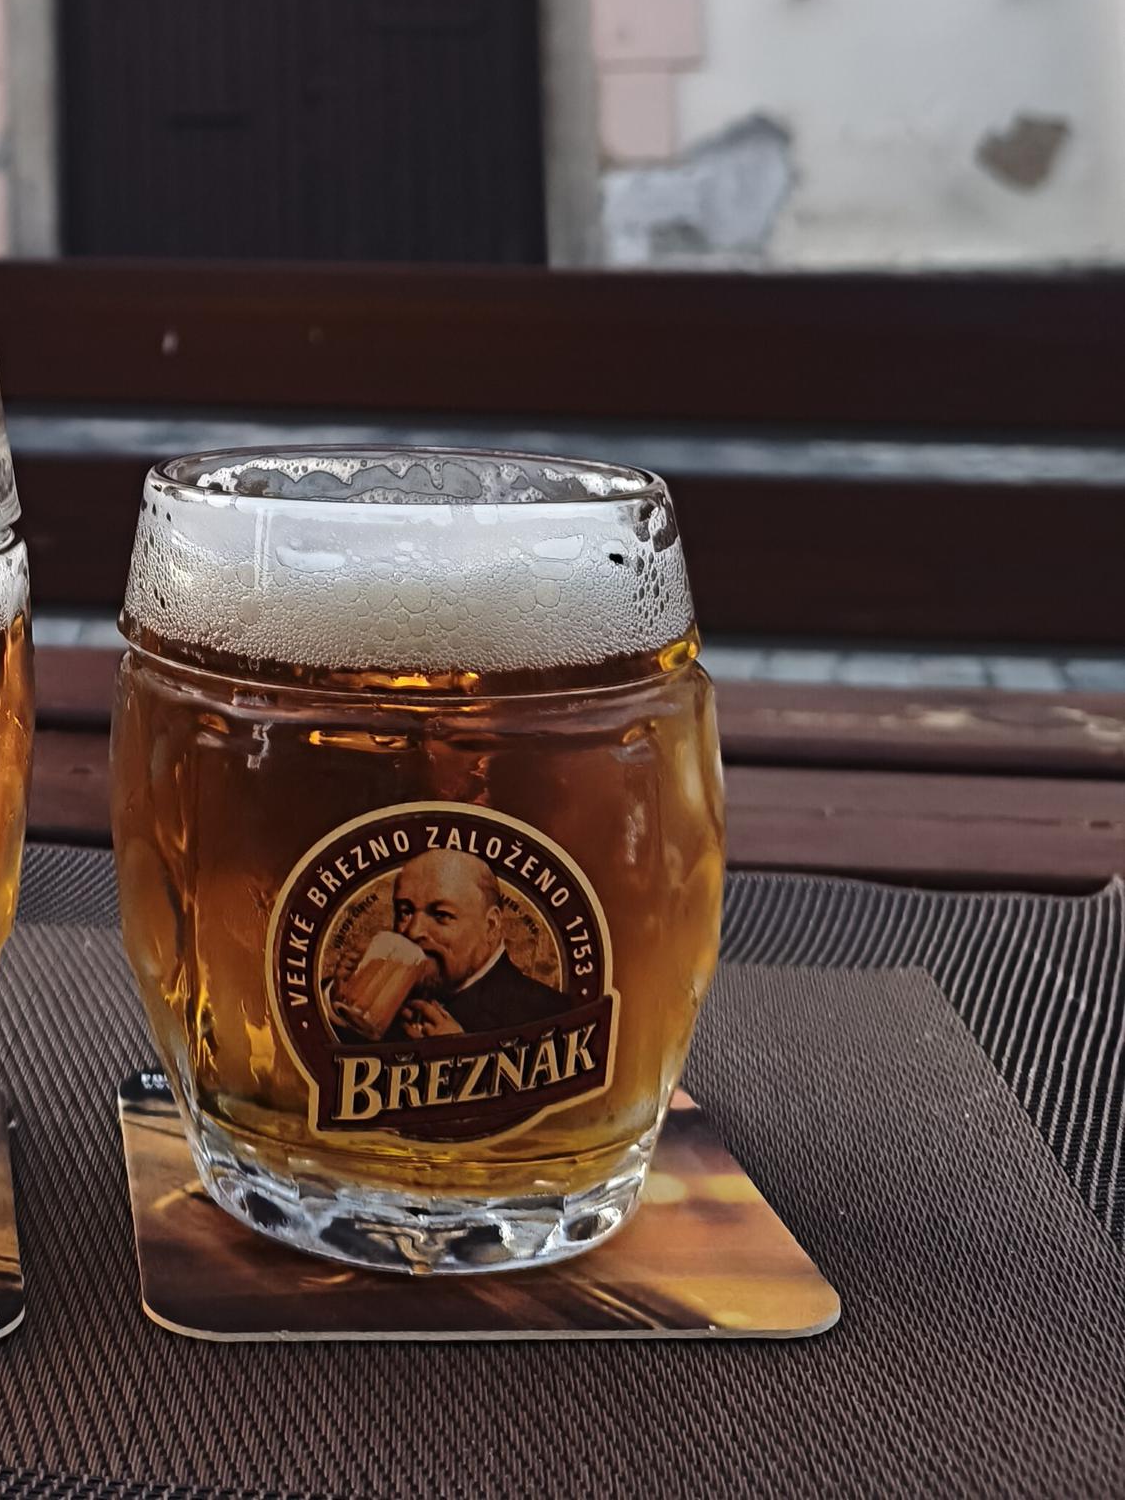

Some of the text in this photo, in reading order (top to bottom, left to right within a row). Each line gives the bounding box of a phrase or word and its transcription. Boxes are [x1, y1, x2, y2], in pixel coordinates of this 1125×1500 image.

[287, 825, 595, 1007] VELKÉ BŘEZNO ZALOŽENO 1753
[332, 1021, 598, 1122] BŘEZŇÁK
